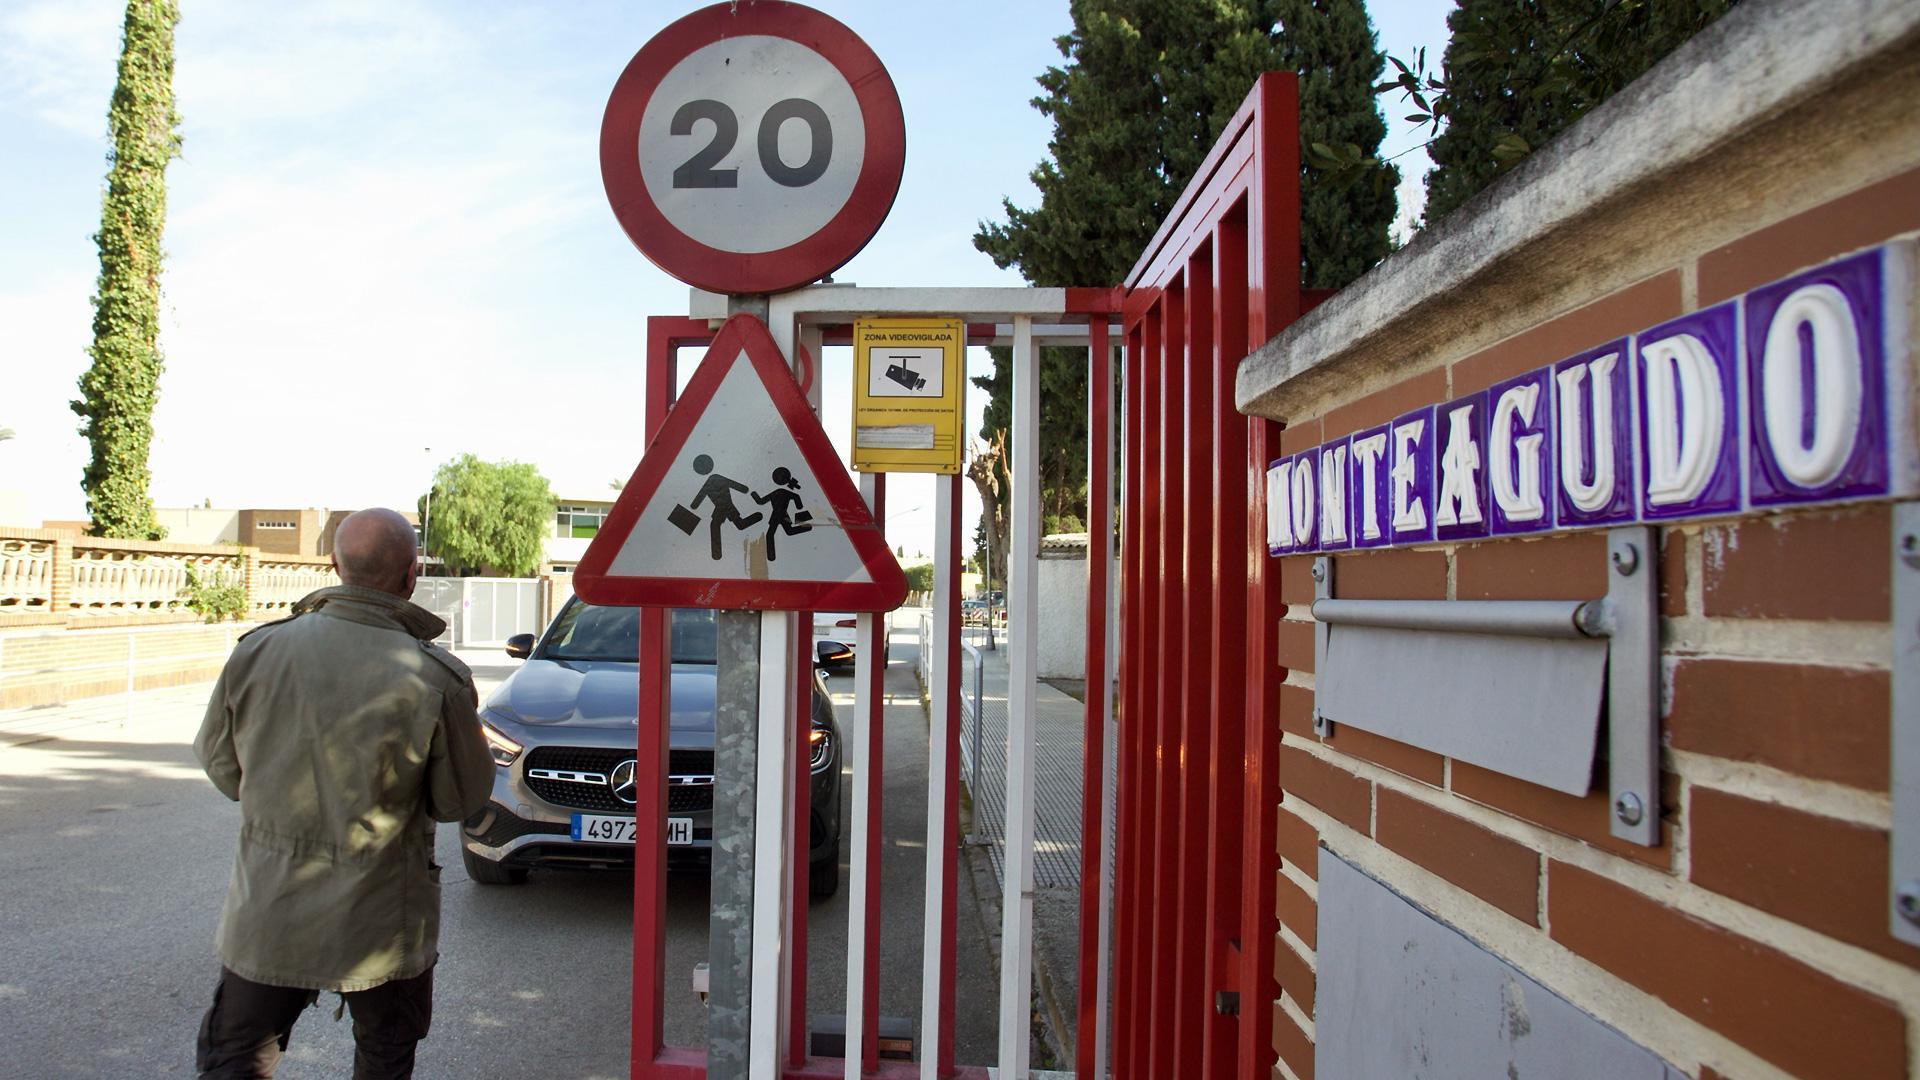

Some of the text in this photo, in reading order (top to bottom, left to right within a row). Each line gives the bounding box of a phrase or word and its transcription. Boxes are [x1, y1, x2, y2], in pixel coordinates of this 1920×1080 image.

[670, 98, 833, 189] 20
[864, 333, 953, 341] ZONA VIDEOVIGILADA
[1266, 282, 1863, 548] MONTEAGUDO
[588, 819, 688, 842] 4972 MH
